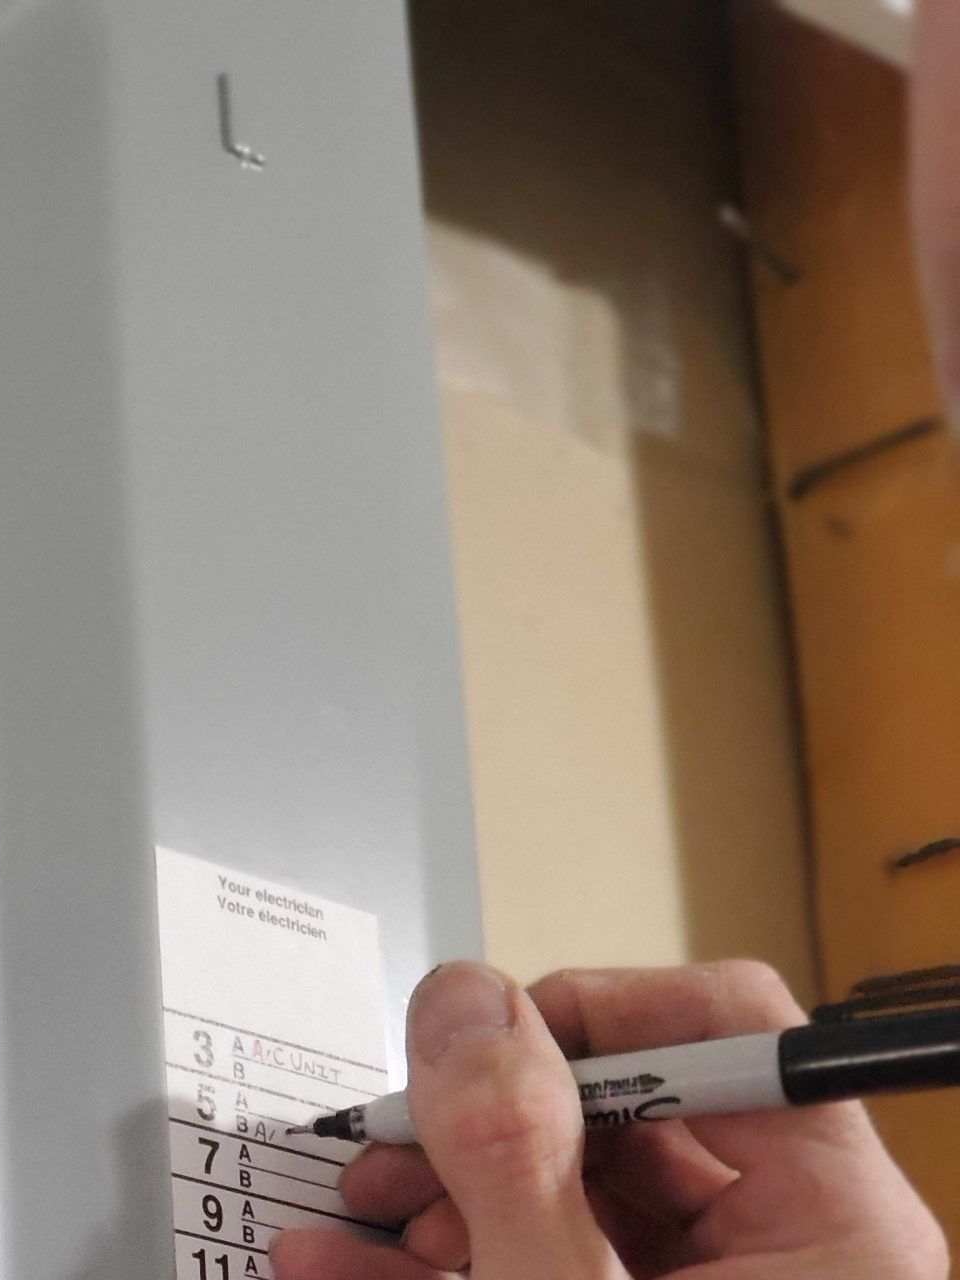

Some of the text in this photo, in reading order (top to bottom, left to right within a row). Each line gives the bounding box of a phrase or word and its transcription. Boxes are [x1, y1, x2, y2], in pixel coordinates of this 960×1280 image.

[218, 874, 251, 897] Your
[217, 894, 255, 918] Votre
[193, 1030, 215, 1068] 3
[233, 1036, 244, 1055] A
[233, 1062, 245, 1080] B
[290, 1052, 342, 1086] UNIT
[196, 1083, 217, 1121] 5
[236, 1091, 249, 1109] A
[236, 1115, 249, 1133] B
[198, 1137, 220, 1175] 7
[239, 1143, 252, 1163] A
[239, 1169, 252, 1189] B
[202, 1194, 224, 1233] 9
[241, 1200, 255, 1219] A
[242, 1224, 256, 1244] B
[244, 1254, 259, 1275] A
